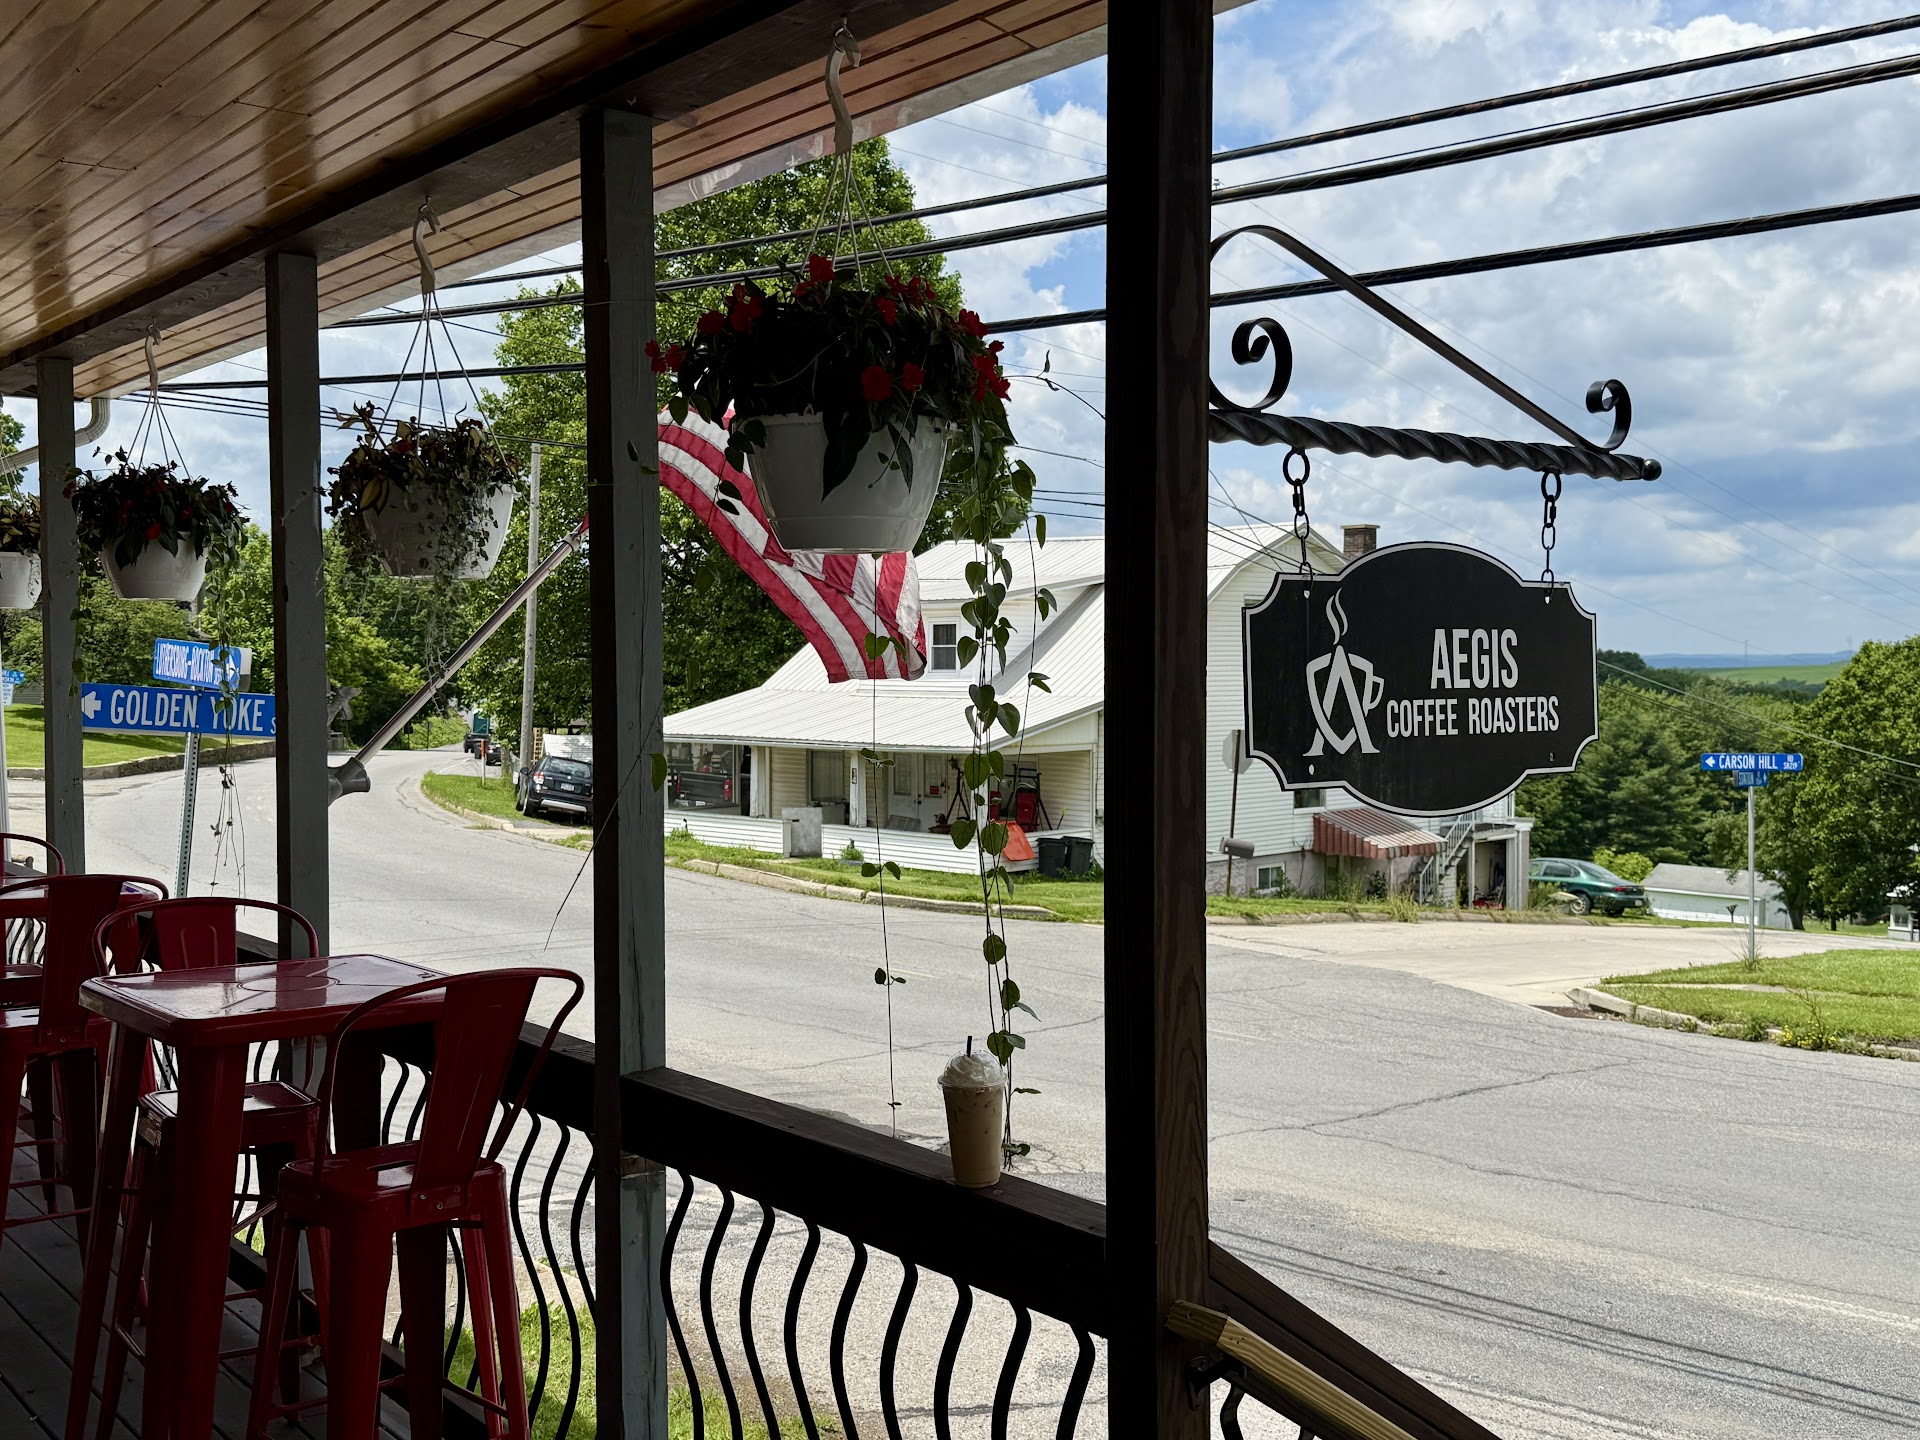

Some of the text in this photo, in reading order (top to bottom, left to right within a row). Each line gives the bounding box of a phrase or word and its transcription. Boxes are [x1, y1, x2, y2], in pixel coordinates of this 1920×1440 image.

[1430, 628, 1519, 690] AEGIS
[110, 689, 277, 734] GOLDEN YOKE S
[1386, 696, 1560, 738] COFFEE ROASTERS
[1718, 755, 1778, 770] CARSON HILL
